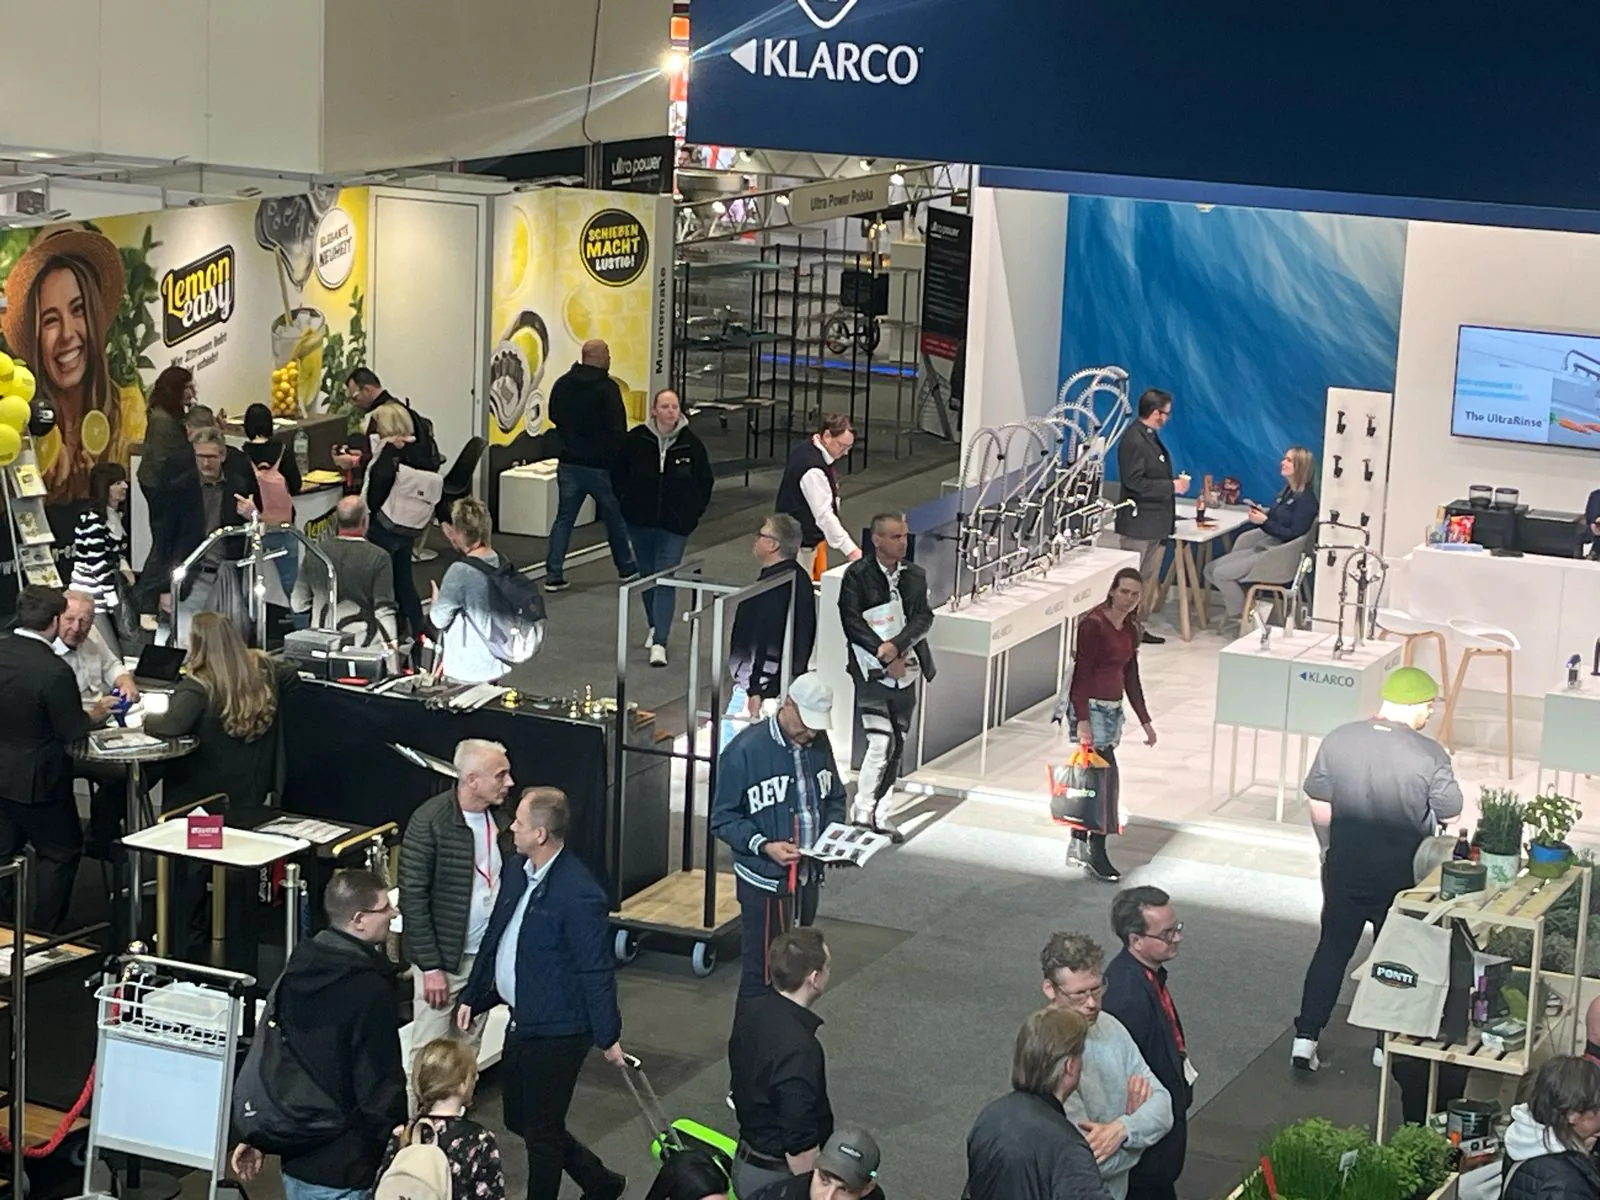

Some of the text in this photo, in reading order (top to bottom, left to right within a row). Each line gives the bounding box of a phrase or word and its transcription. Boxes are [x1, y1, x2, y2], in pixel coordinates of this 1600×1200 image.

[763, 38, 919, 85] KLARCO
[586, 236, 641, 259] MACHT
[182, 279, 230, 328] easy
[1465, 410, 1543, 428] The UltraRinse
[1308, 671, 1355, 688] KLARCO
[747, 775, 790, 815] REV
[1376, 966, 1413, 984] PONTI
